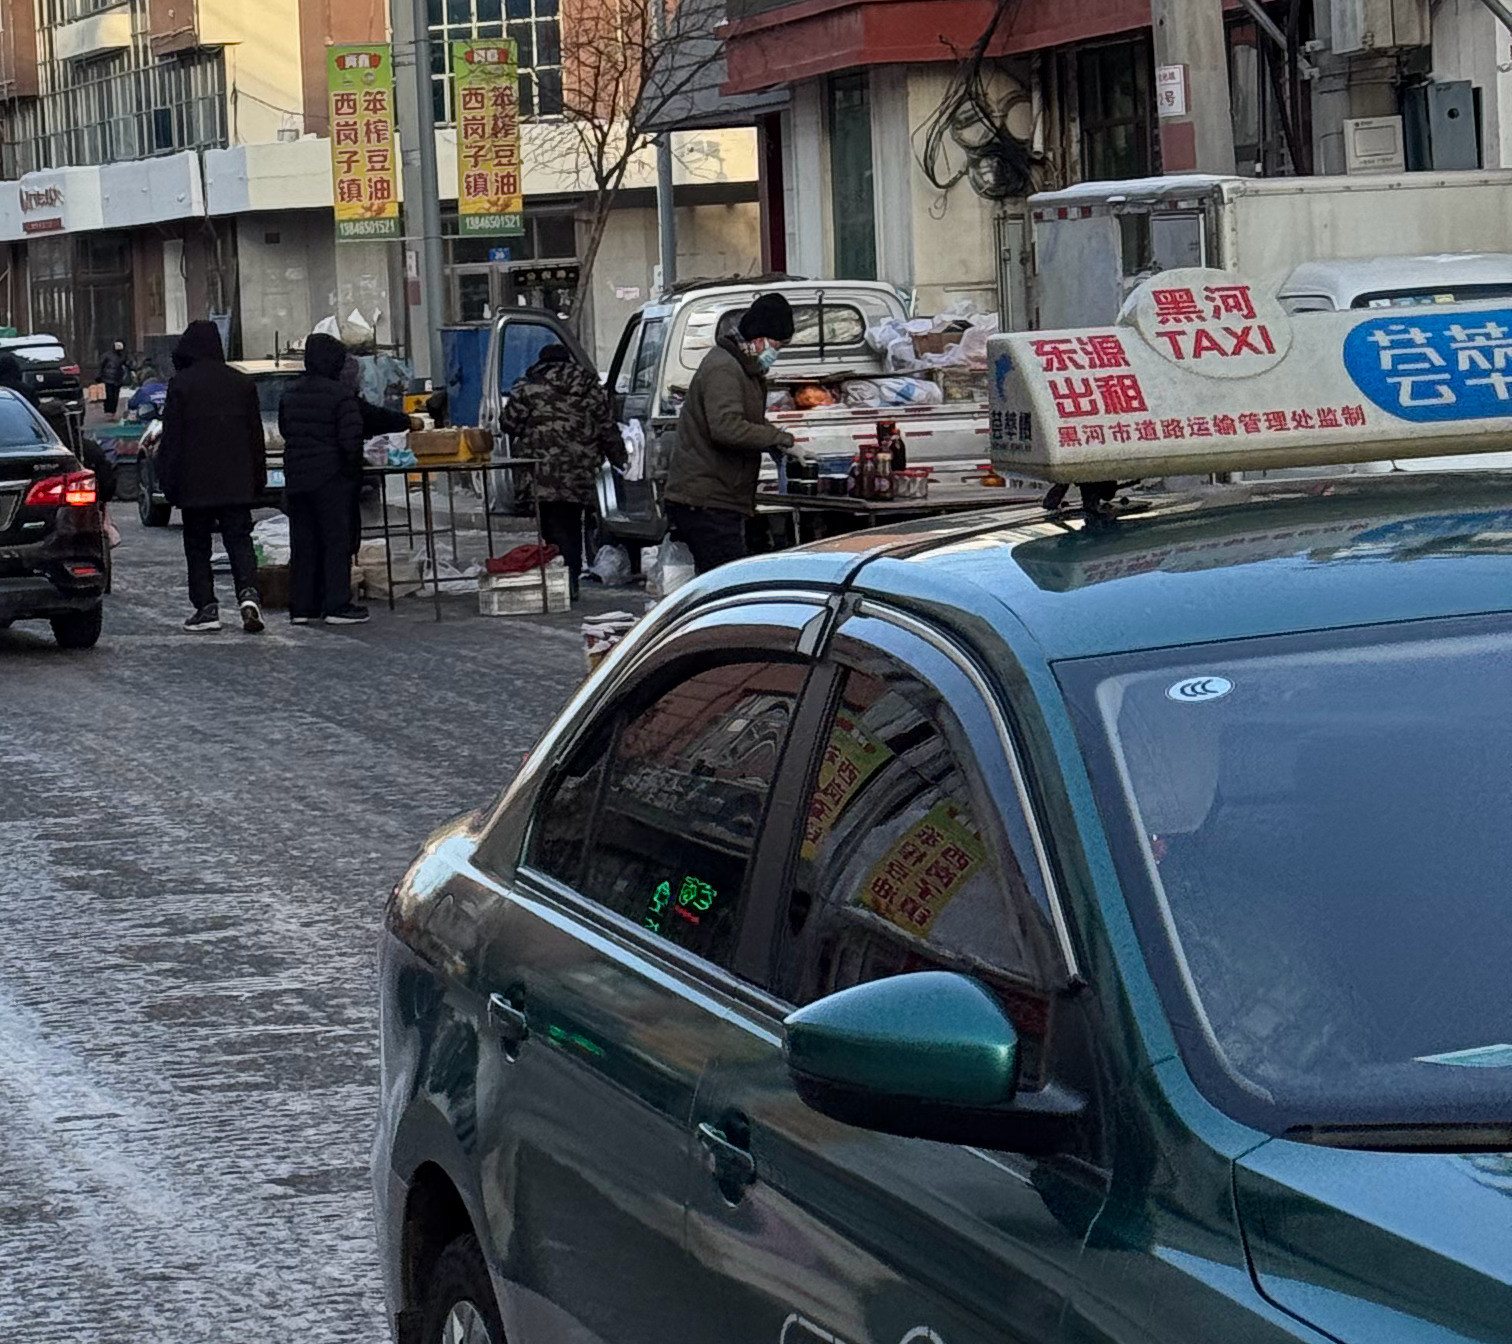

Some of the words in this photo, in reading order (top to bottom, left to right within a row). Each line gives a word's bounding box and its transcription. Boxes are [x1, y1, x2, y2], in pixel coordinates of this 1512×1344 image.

[333, 93, 364, 203] 西岗子镇
[363, 91, 392, 202] 笨榨豆油
[462, 87, 489, 198] 西岗子镇
[491, 86, 518, 197] 笨榨豆油
[339, 220, 395, 236] 13846501521
[466, 215, 521, 231] 13846501521
[1152, 285, 1257, 324] 黑河
[1029, 334, 1131, 372] 东源
[1155, 325, 1276, 360] TAXI
[1048, 373, 1148, 418] 出租
[1057, 403, 1368, 448] 黑河市道路运输管理处监制
